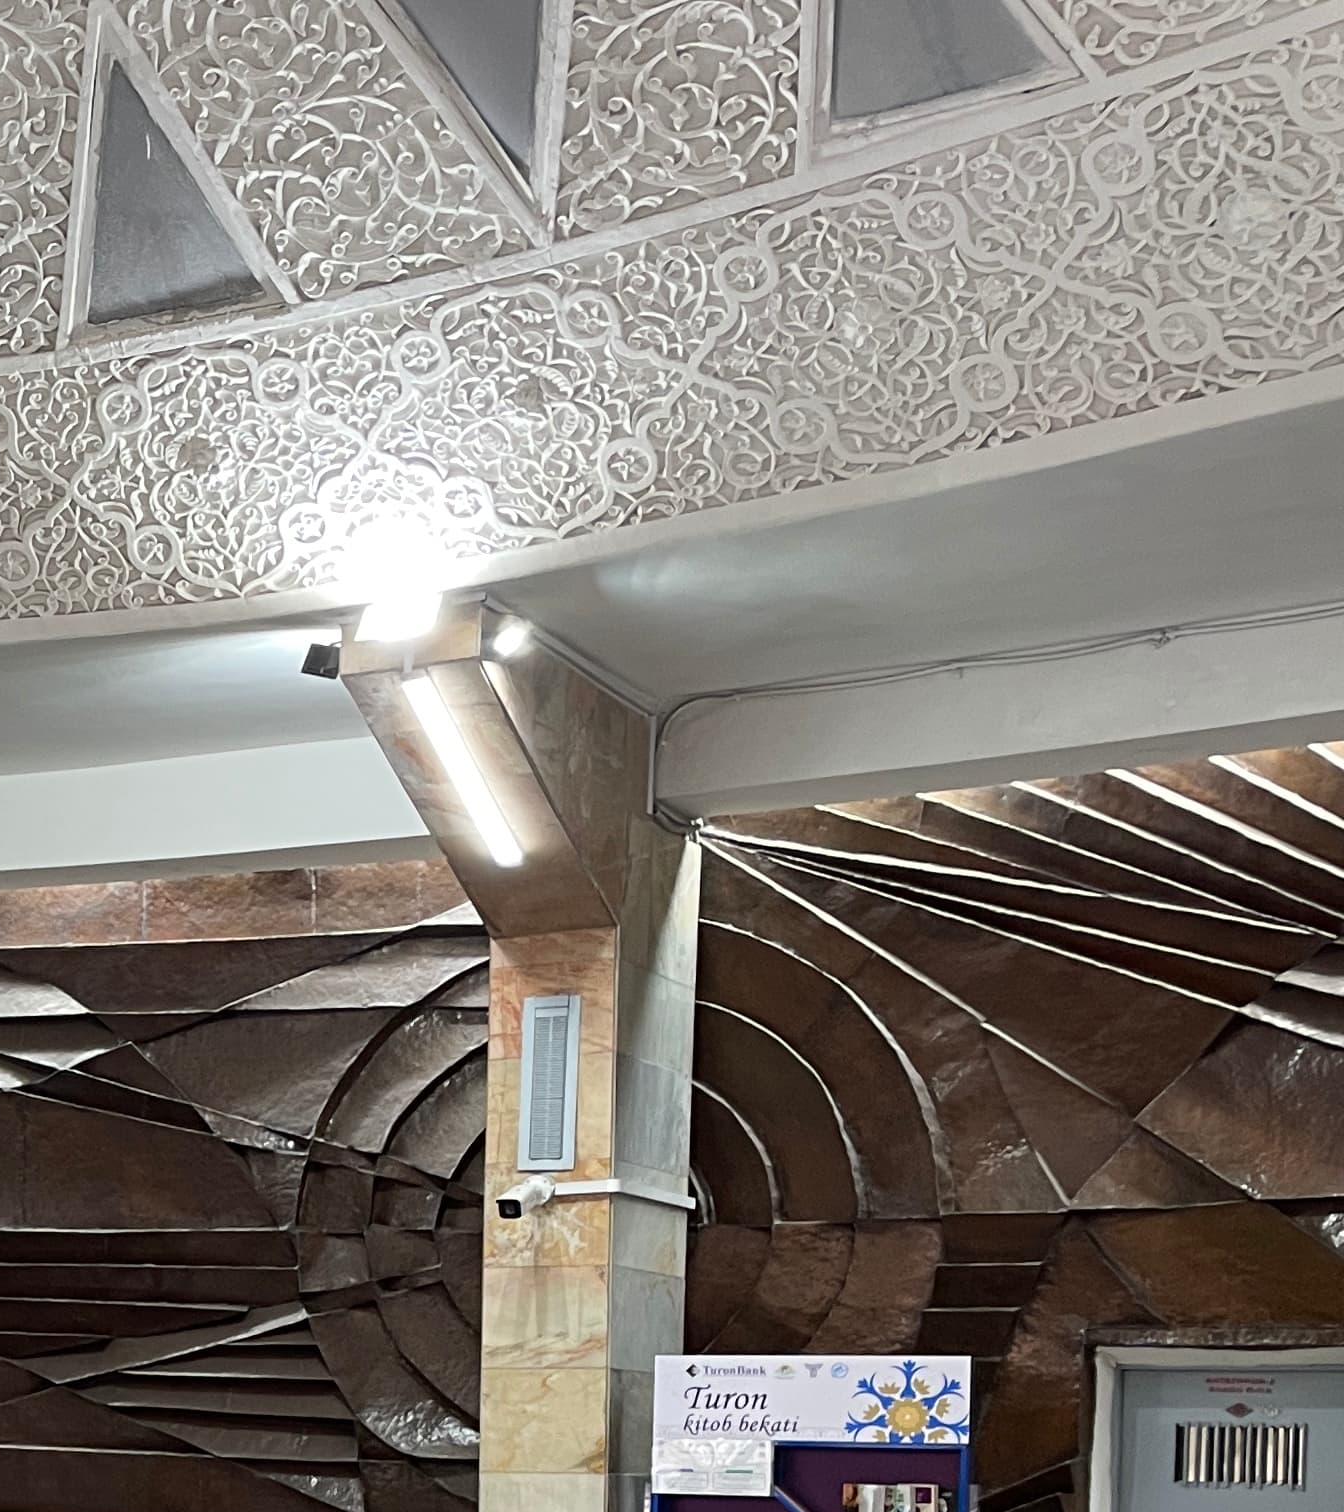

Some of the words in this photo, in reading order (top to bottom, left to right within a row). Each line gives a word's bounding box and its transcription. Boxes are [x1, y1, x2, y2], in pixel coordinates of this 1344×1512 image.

[703, 1364, 767, 1377] TuronBank
[683, 1384, 768, 1410] Turon
[683, 1413, 733, 1436] kitob
[738, 1414, 800, 1437] bekati
